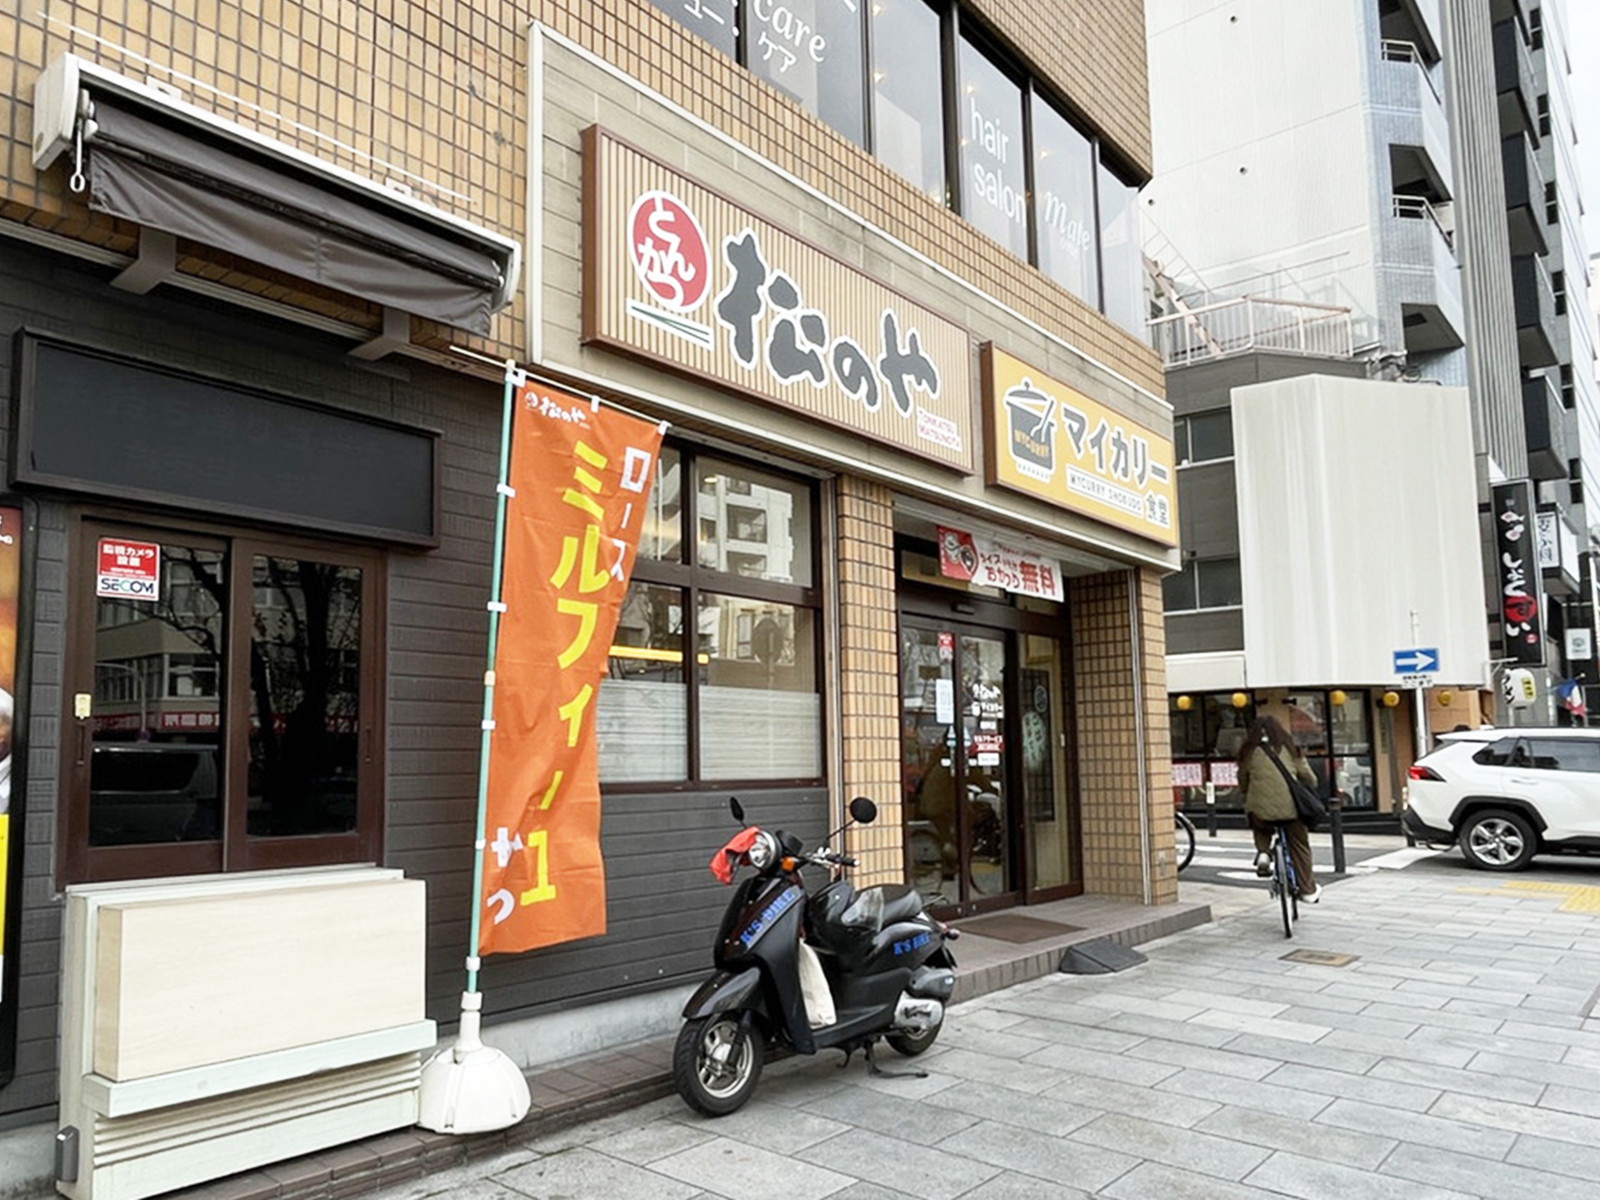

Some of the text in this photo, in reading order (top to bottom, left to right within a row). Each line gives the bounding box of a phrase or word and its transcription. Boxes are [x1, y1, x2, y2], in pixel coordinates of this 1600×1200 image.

[754, 0, 826, 62] care
[758, 32, 797, 73] ケア
[970, 97, 1009, 164] hair
[974, 163, 1027, 228] salon
[717, 232, 940, 414] 松のや
[1062, 405, 1168, 486] マイカリー
[610, 446, 652, 582] ロース
[101, 577, 154, 594] SECOM
[1019, 560, 1056, 596] 無料
